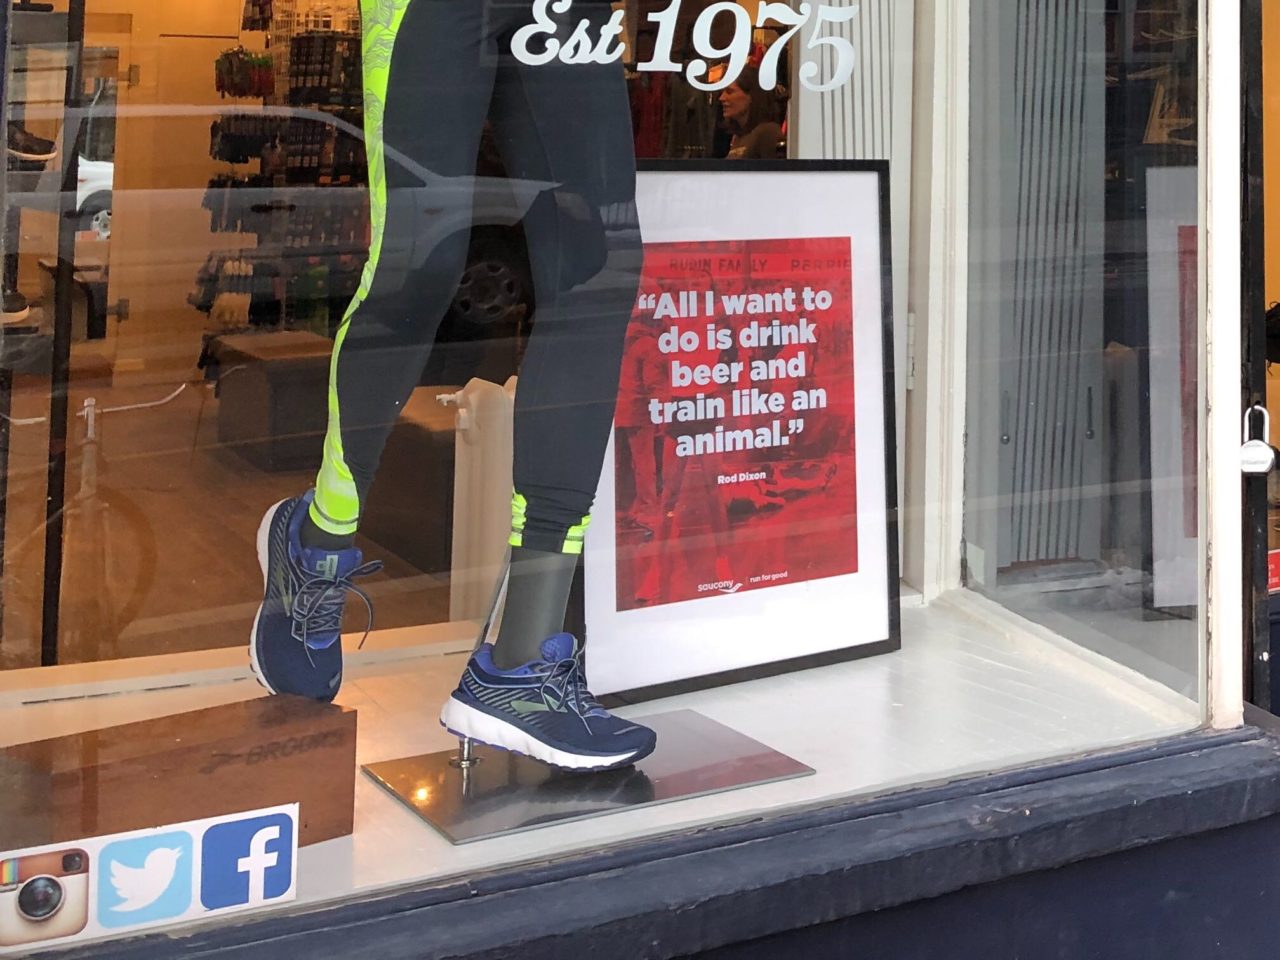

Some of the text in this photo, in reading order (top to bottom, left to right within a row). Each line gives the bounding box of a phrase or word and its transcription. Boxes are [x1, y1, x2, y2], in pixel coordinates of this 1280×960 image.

[705, 291, 714, 316] I
[721, 288, 796, 315] want
[802, 287, 832, 311] to
[658, 318, 817, 353] do is drink
[671, 352, 806, 387] beer and
[648, 388, 827, 425] train like an
[718, 471, 766, 484] Rod Dixon
[698, 580, 734, 591] saucony
